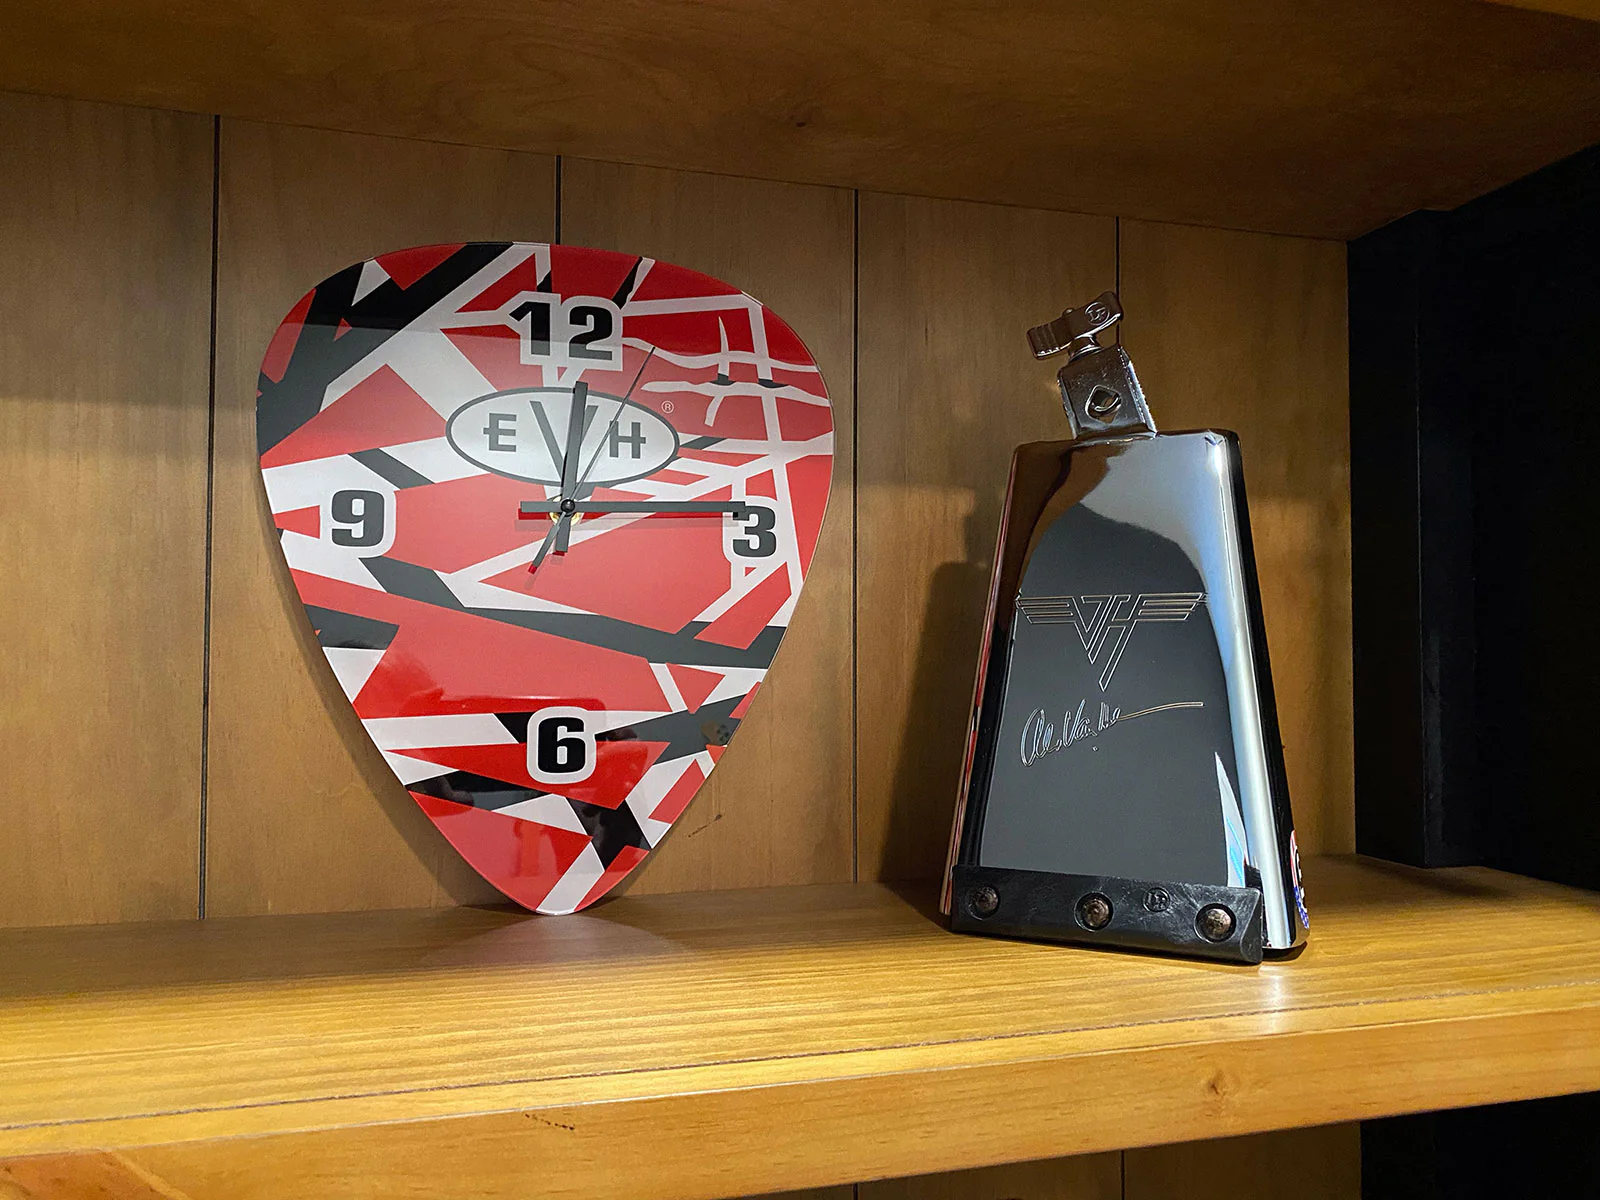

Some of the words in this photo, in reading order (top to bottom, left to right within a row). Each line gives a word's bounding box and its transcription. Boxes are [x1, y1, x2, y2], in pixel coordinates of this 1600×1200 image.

[508, 300, 613, 360] 12
[483, 400, 646, 480] EVH
[331, 490, 385, 547] 9
[732, 505, 777, 558] 3
[537, 716, 586, 774] 6
